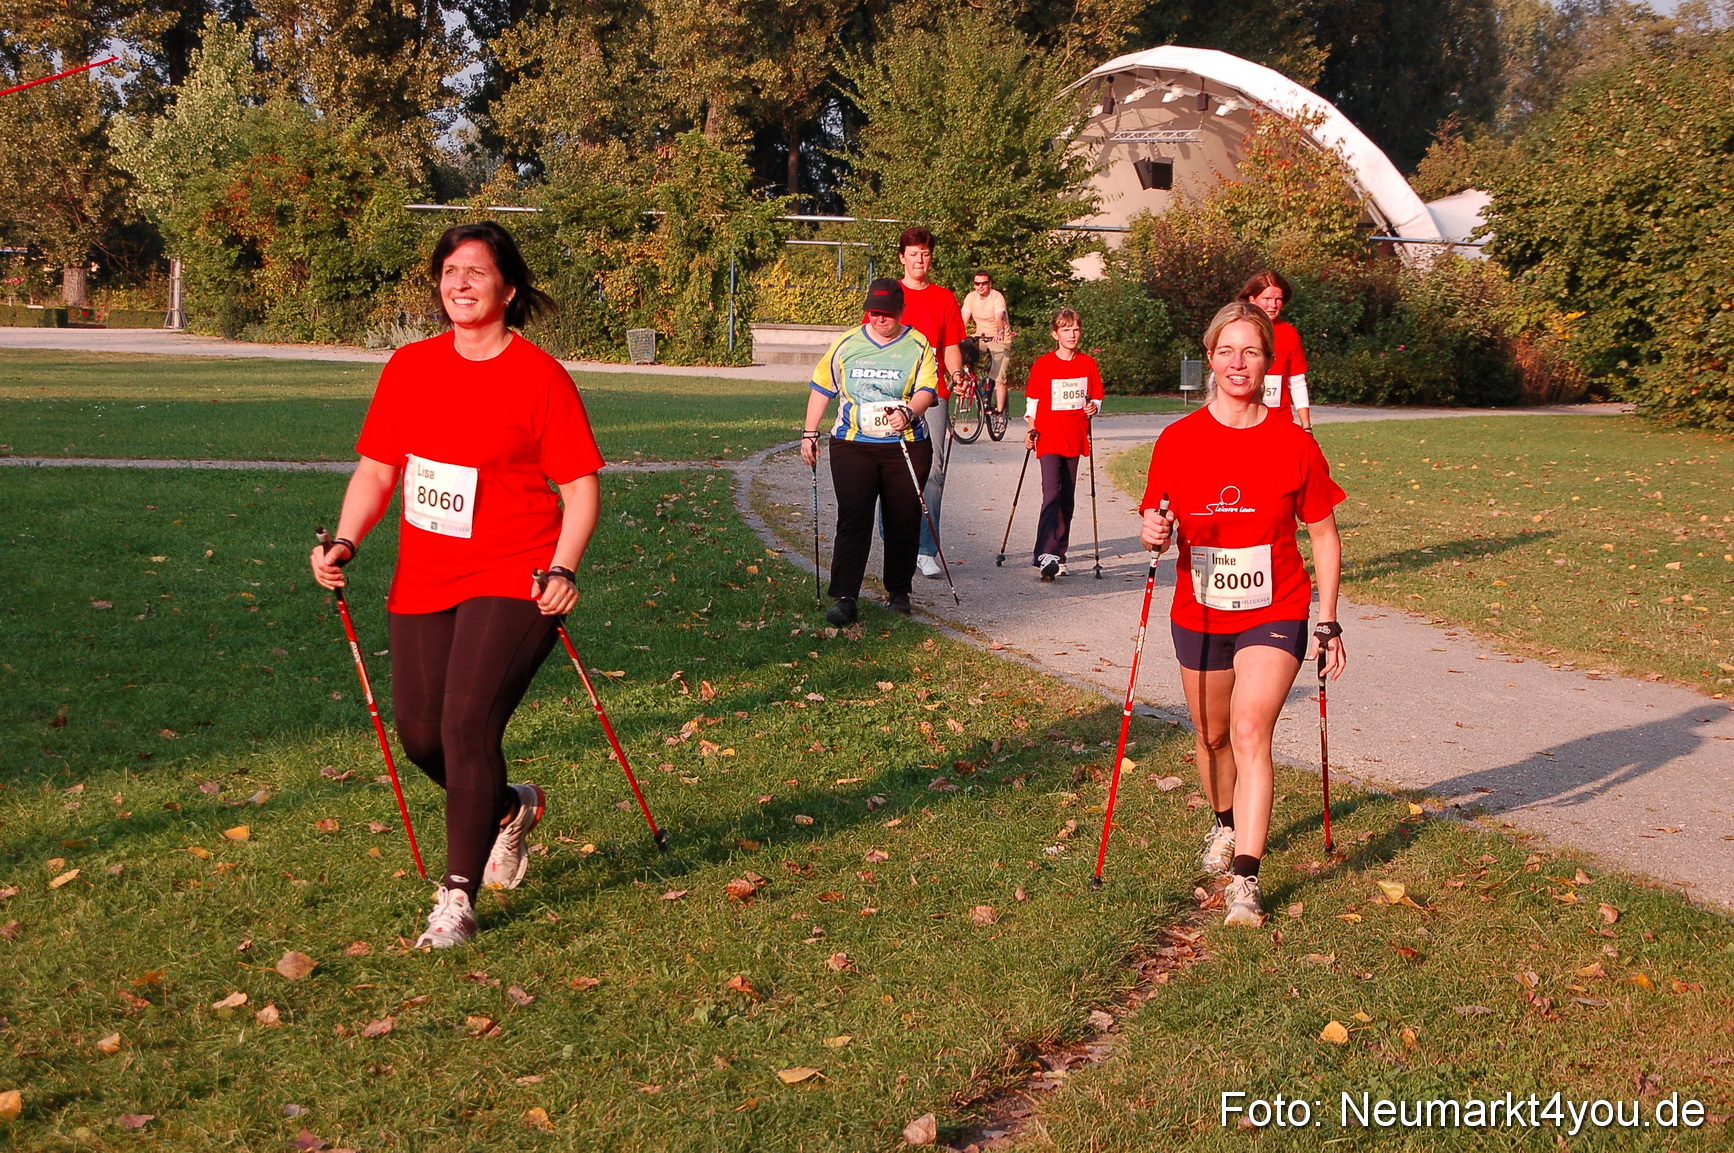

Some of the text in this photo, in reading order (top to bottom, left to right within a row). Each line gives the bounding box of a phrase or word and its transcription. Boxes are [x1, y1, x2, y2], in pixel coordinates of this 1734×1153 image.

[851, 368, 902, 380] BOCK
[1063, 389, 1085, 400] 8058
[1266, 387, 1277, 397] 57
[874, 416, 889, 427] 80
[417, 463, 435, 480] Lisa
[417, 485, 464, 513] 8060
[1212, 552, 1236, 566] Imke
[1214, 570, 1264, 590] 8000
